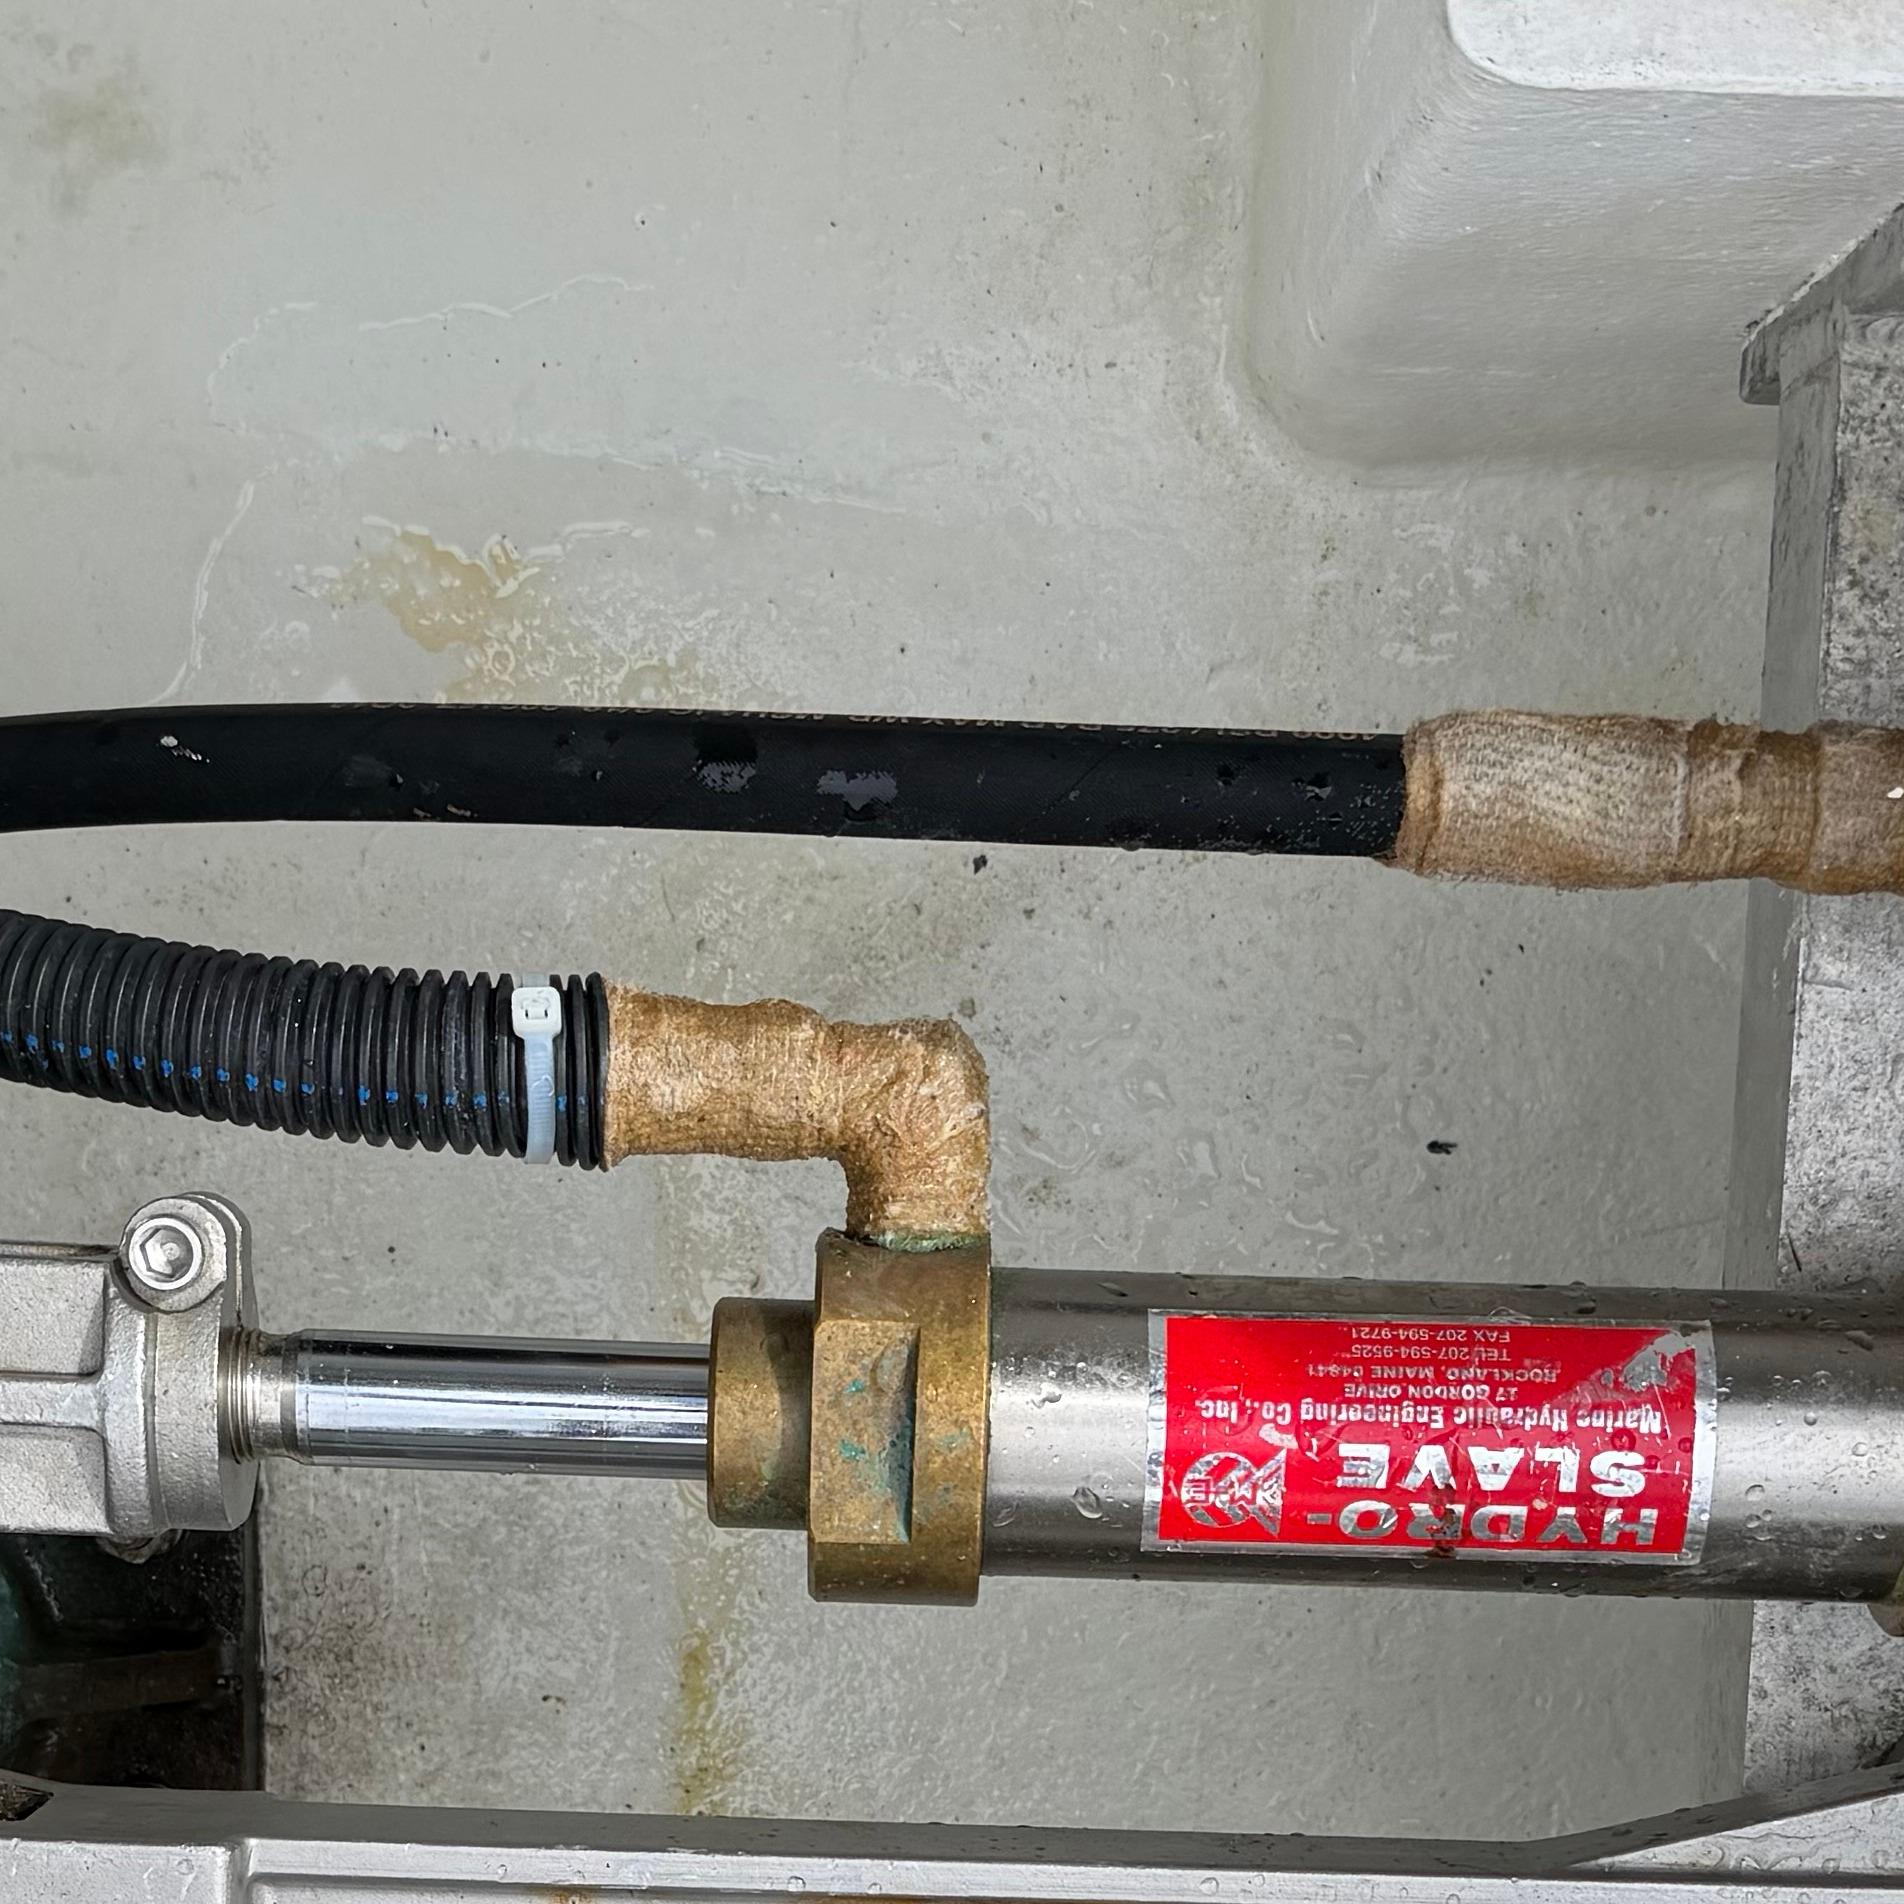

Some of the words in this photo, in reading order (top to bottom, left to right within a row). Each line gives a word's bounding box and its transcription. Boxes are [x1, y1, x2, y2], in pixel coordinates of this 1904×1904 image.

[1351, 1327, 1468, 1342] 207-594-9721
[1473, 1328, 1511, 1343] FAX
[1351, 1344, 1469, 1360] 207-594-9525
[1371, 1365, 1436, 1381] MAINE
[1407, 1384, 1491, 1401] GORDON
[1195, 1400, 1239, 1424] Inc.
[1300, 1398, 1445, 1429] Engineering
[1453, 1403, 1568, 1432] Hydraulic
[1576, 1404, 1662, 1434] Marine
[1336, 1443, 1646, 1498] SLAVE
